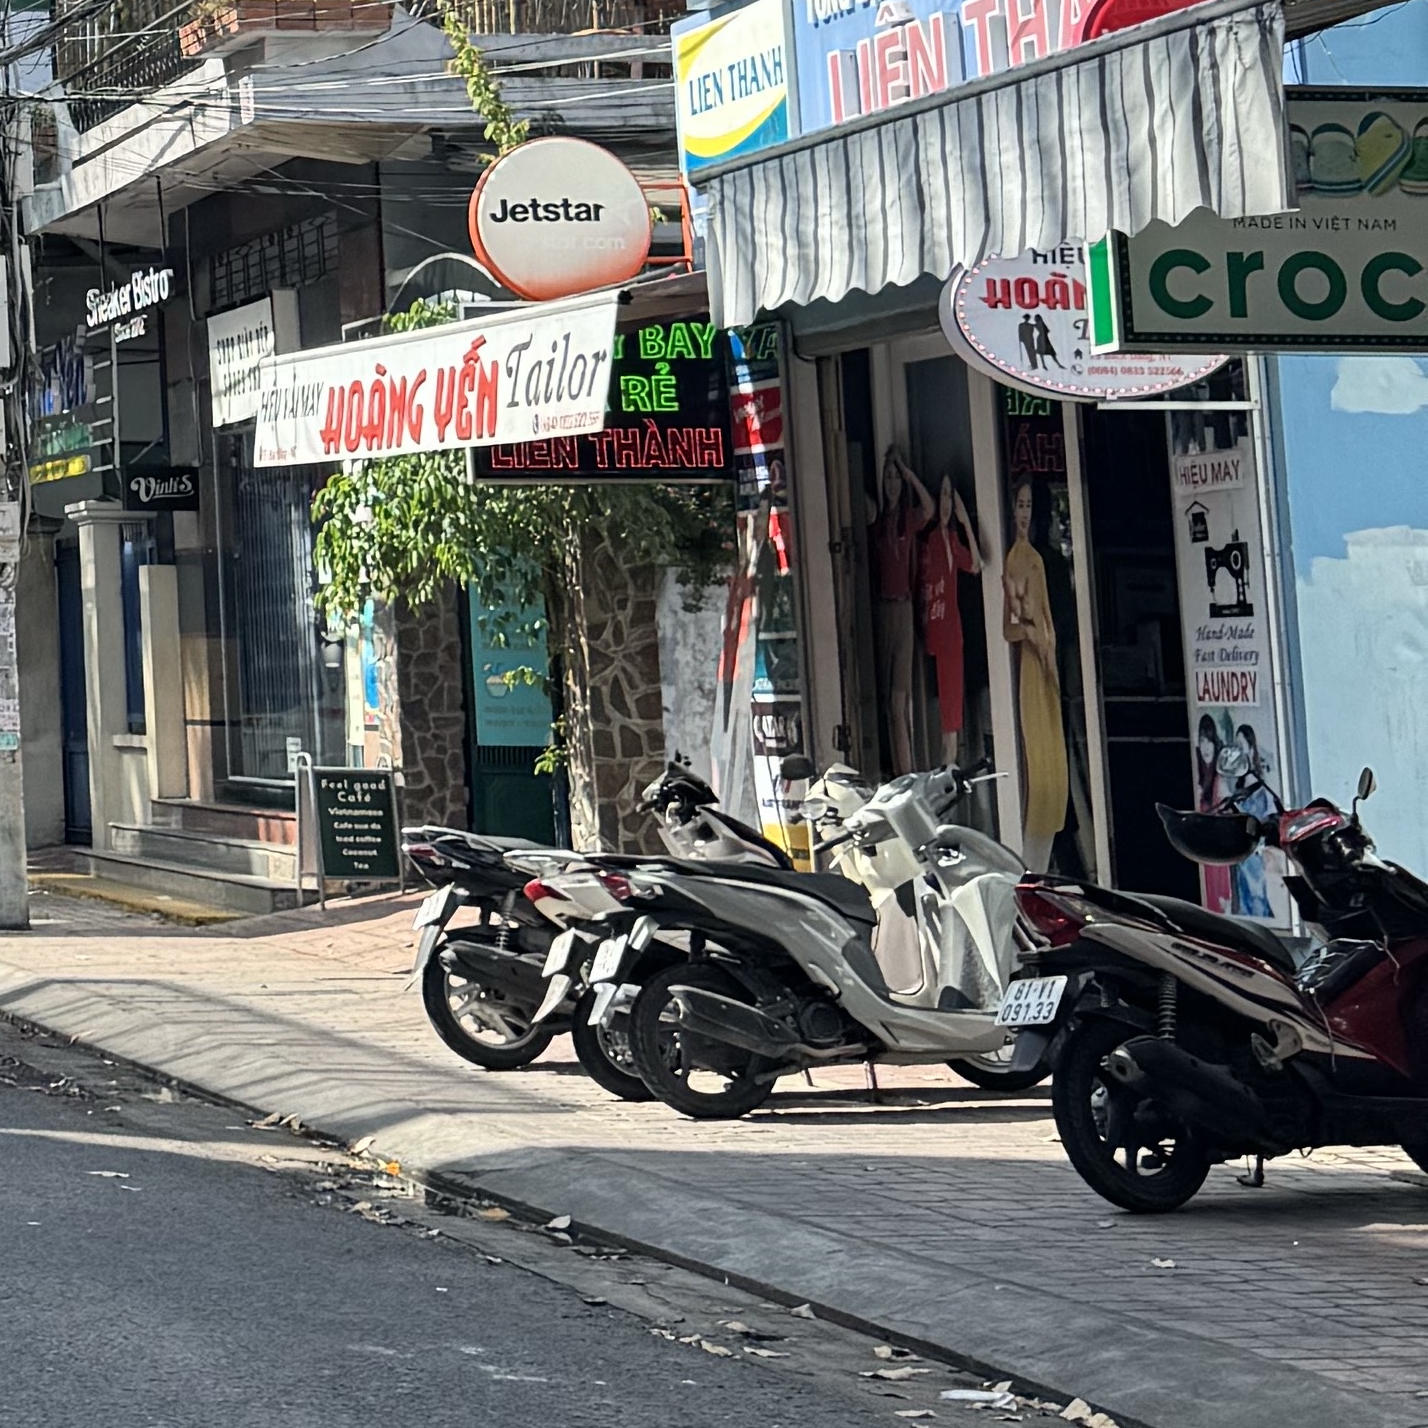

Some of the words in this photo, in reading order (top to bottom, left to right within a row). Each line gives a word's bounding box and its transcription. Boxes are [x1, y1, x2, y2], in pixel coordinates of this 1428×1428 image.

[489, 198, 607, 223] Jetstar
[1233, 216, 1283, 230] MADE
[1289, 217, 1307, 230] IN
[1312, 214, 1350, 232] VIỆT
[1358, 219, 1397, 231] NAM
[86, 280, 132, 328] Sneaker
[132, 267, 174, 310] Bistro
[1149, 249, 1427, 323] croc
[639, 322, 717, 360] BAY
[319, 362, 427, 456] HOÀNG
[432, 334, 498, 444] YẾN
[505, 331, 608, 409] Tailor
[619, 362, 680, 413] RẺ
[588, 417, 725, 469] THÀNH
[1210, 459, 1241, 484] MAY
[1196, 621, 1255, 642] Hand-Made
[1195, 648, 1215, 663] Fast
[1219, 646, 1260, 666] Delivery
[1195, 669, 1258, 704] LAUNDRY
[321, 778, 348, 789] Feel
[353, 778, 386, 792] good
